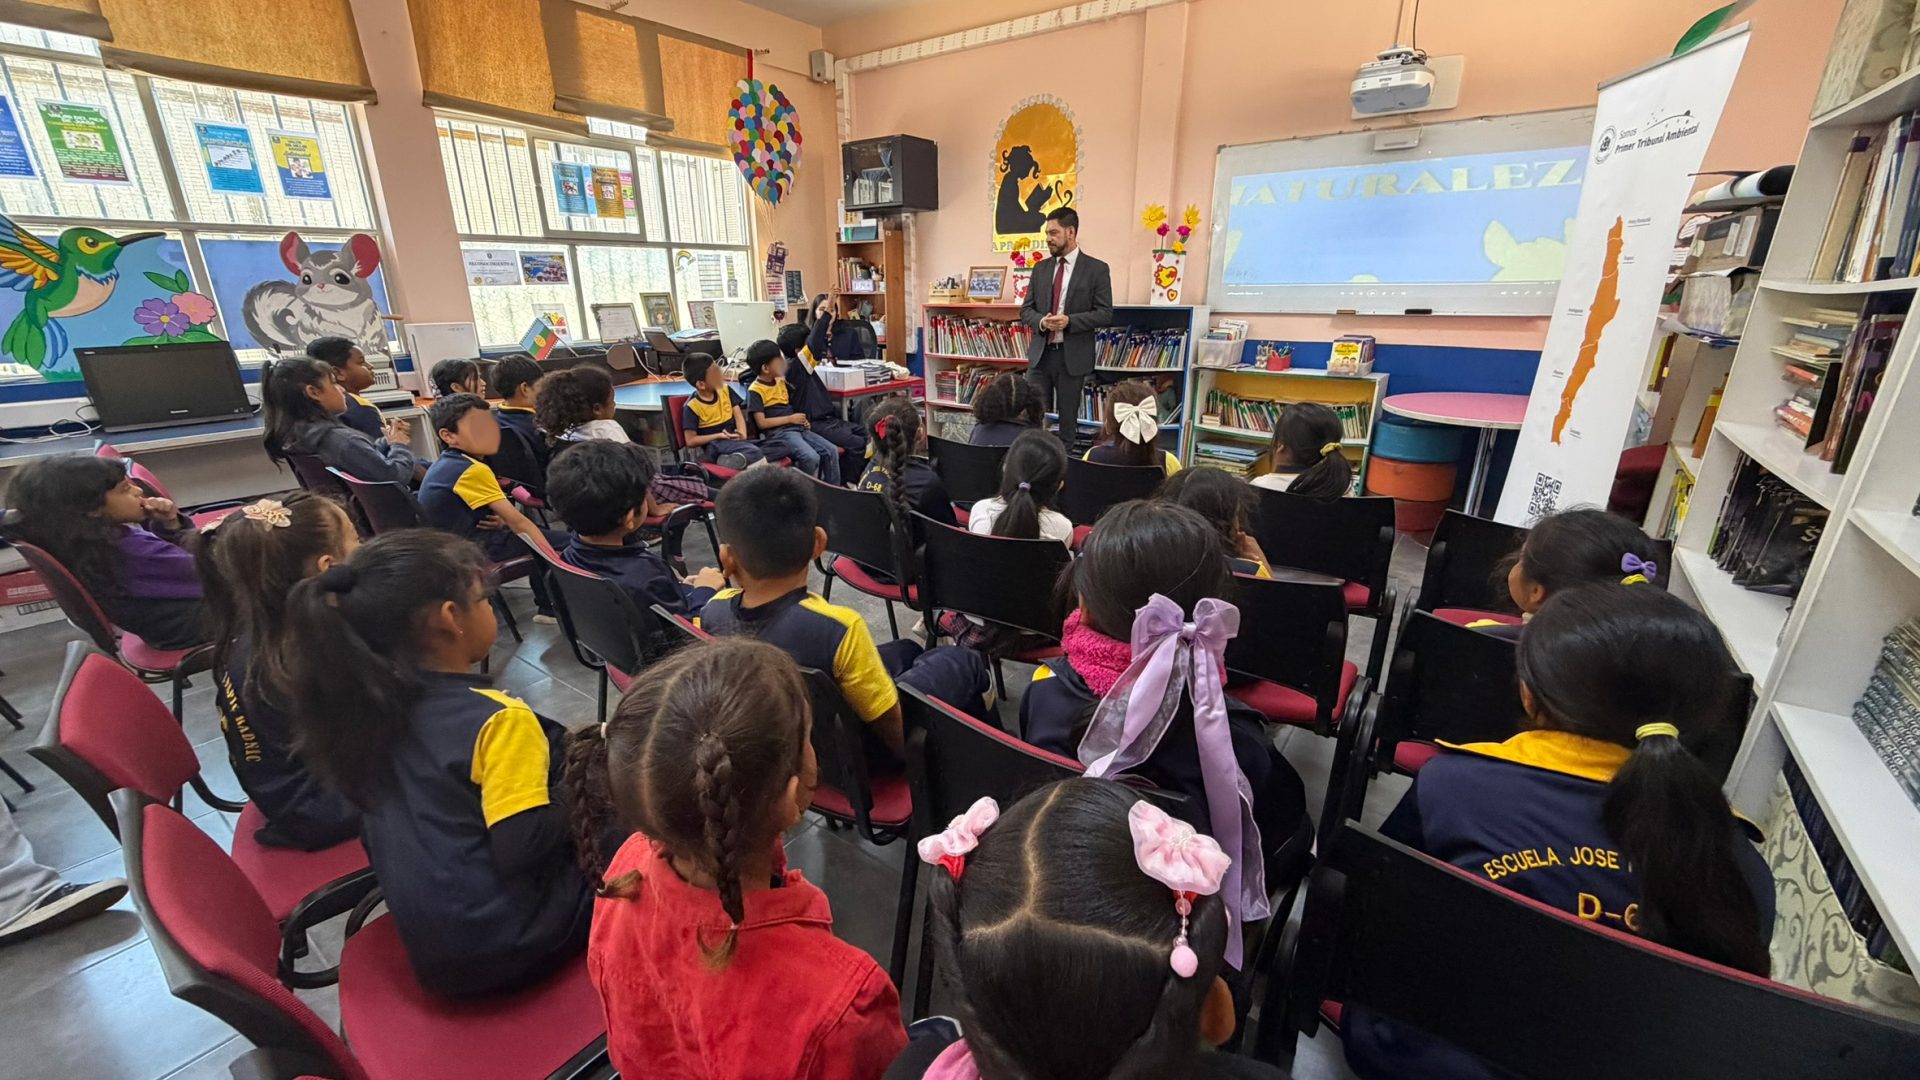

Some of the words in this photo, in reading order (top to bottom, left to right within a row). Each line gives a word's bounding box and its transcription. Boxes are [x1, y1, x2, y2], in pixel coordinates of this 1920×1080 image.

[1615, 143, 1636, 154] Primer
[1637, 132, 1666, 149] Tribunal
[1665, 122, 1699, 141] Ambiental
[1483, 846, 1562, 880] ESCUELA
[1569, 846, 1620, 870] JOSE
